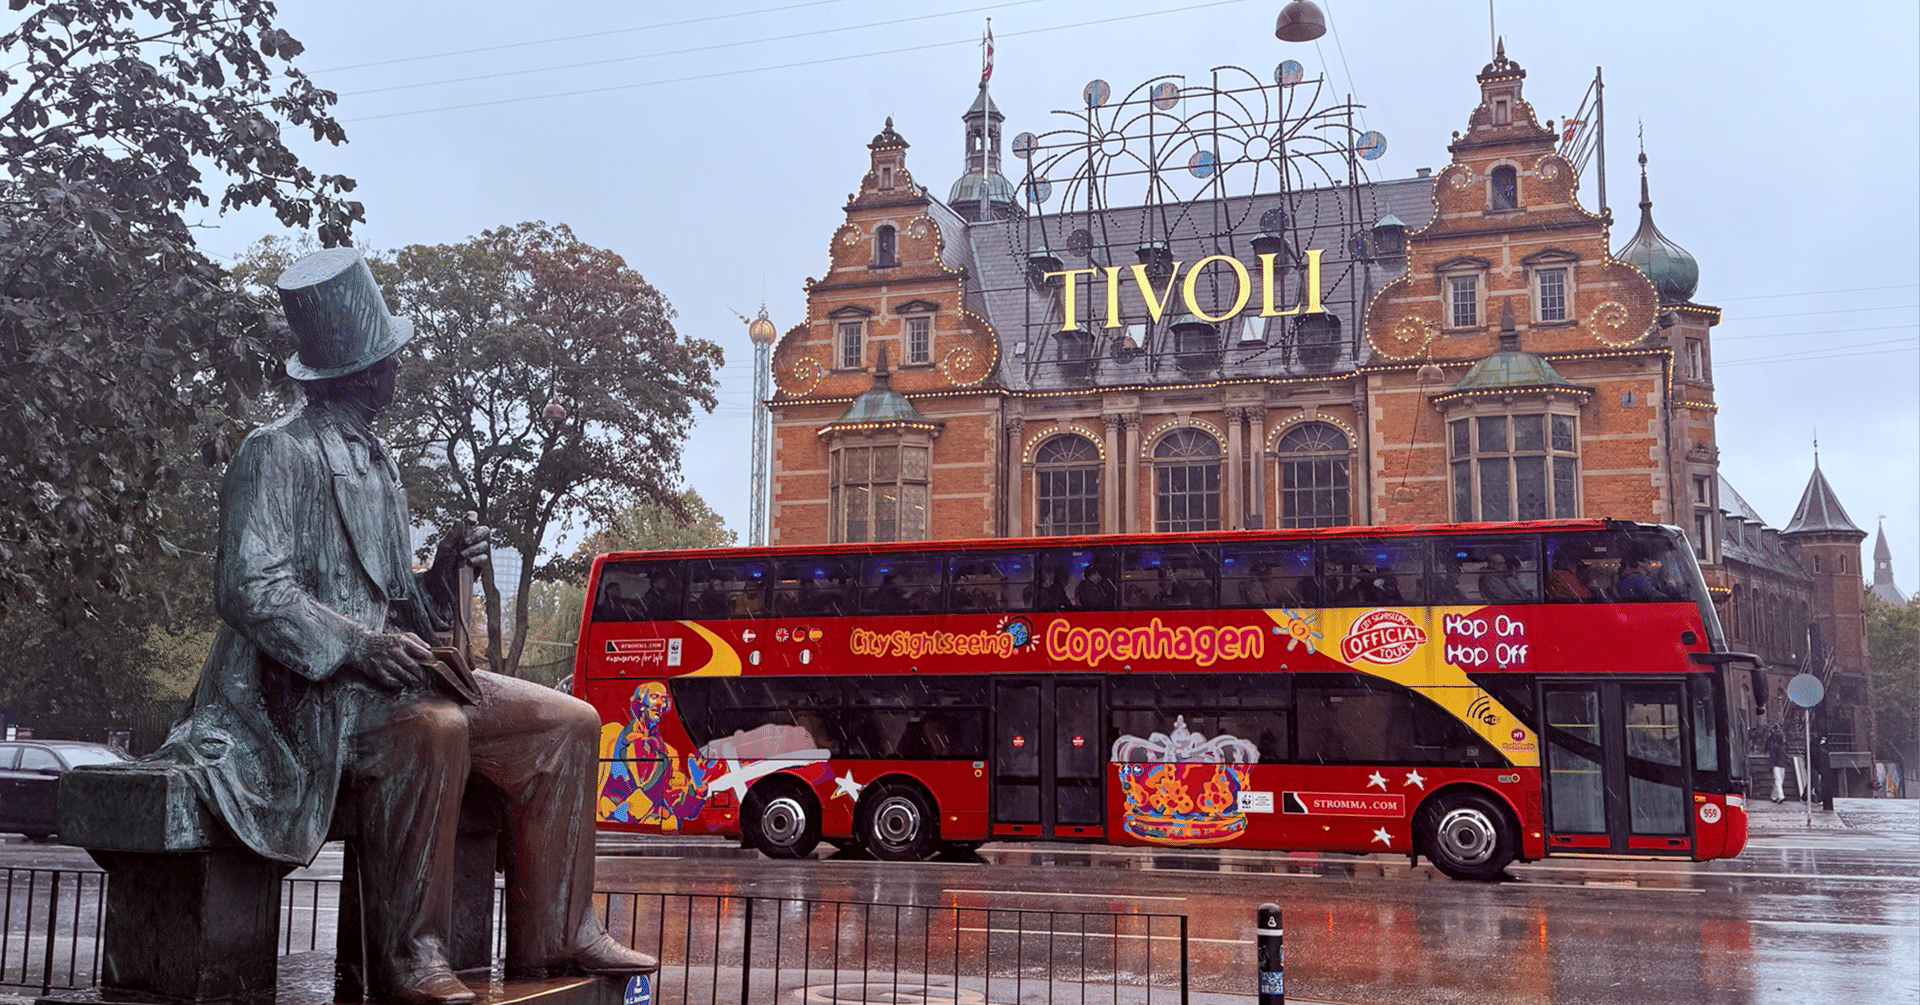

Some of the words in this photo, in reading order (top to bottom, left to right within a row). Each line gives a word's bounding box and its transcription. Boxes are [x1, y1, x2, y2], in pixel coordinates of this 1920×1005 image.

[1043, 249, 1326, 332] TIVOLI
[1446, 615, 1488, 639] Hop
[1495, 614, 1524, 637] On
[1046, 617, 1264, 667] Copenhagen
[1350, 627, 1424, 654] OFFICIAL
[1380, 644, 1411, 659] TOUR
[1447, 643, 1489, 667] Hop
[1495, 643, 1529, 665] Off
[1313, 798, 1398, 811] STROMMA.COM
[1703, 808, 1718, 818] 959
